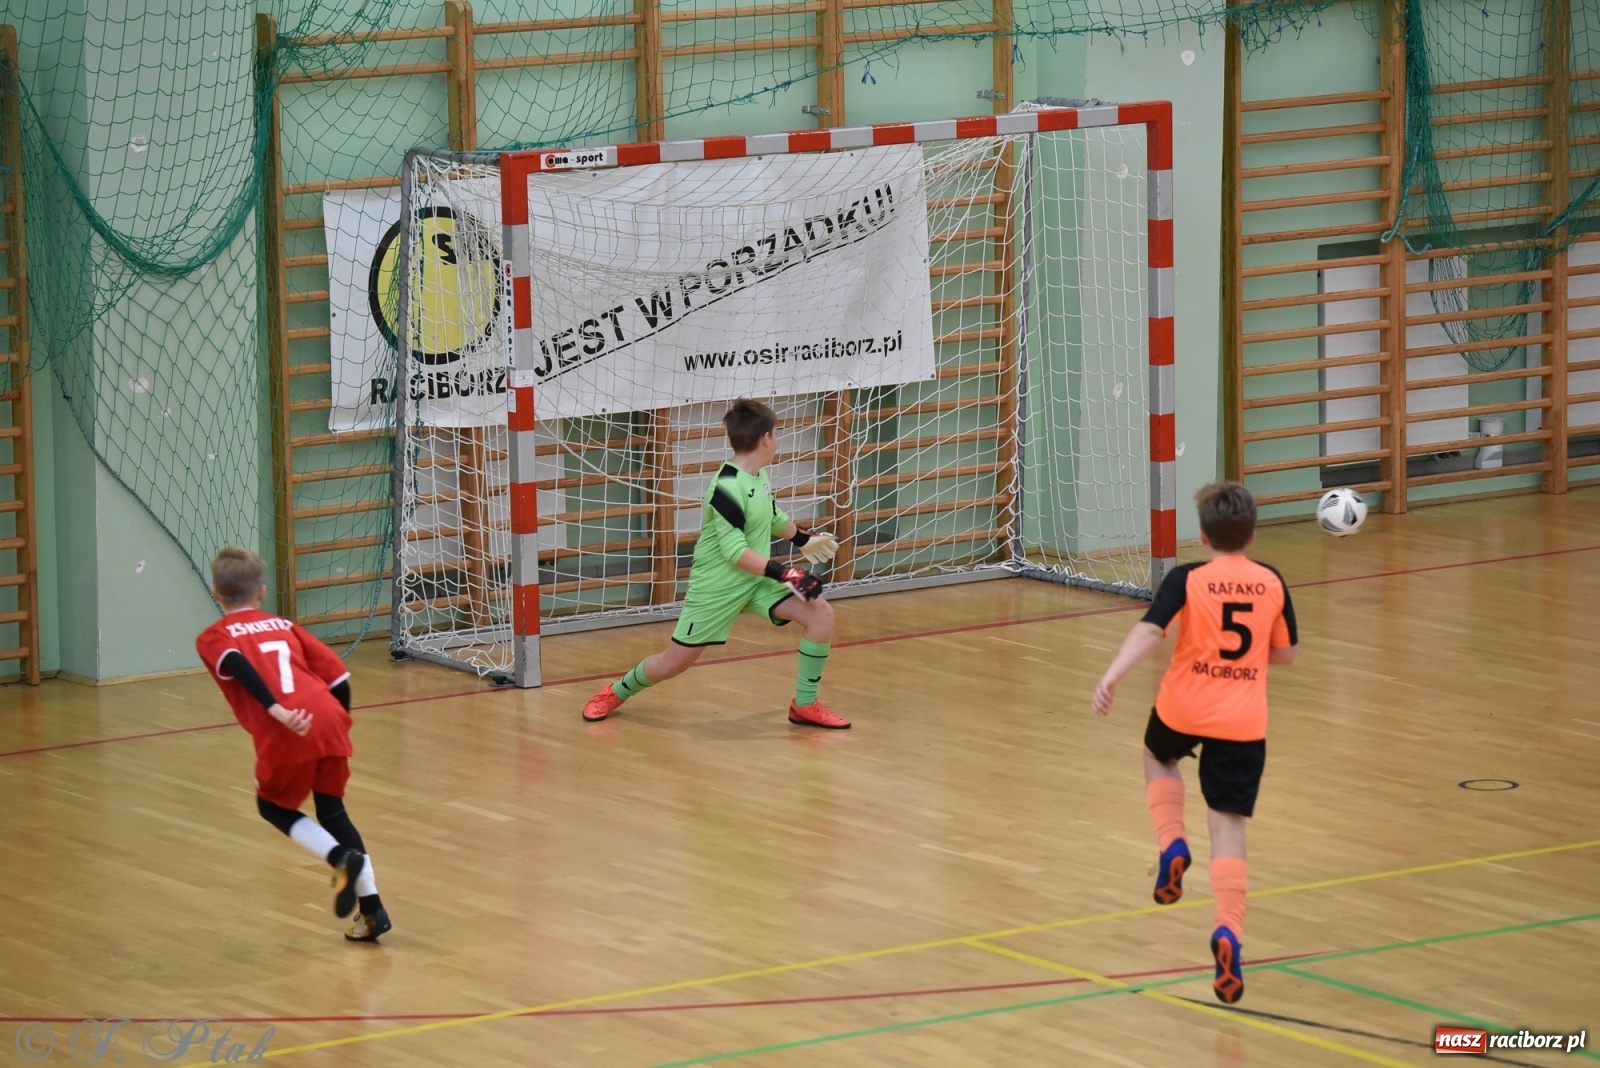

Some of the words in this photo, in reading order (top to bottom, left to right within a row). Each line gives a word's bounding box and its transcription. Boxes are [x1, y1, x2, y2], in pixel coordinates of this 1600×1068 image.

[576, 153, 603, 165] sport
[534, 305, 625, 377] JEST
[635, 284, 672, 328] W
[685, 330, 903, 372] www.osir-raciborz.pl
[1208, 582, 1266, 596] RAFAKO
[1219, 602, 1253, 660] 5
[258, 640, 295, 694] 7
[1192, 661, 1258, 681] RACIBORZ
